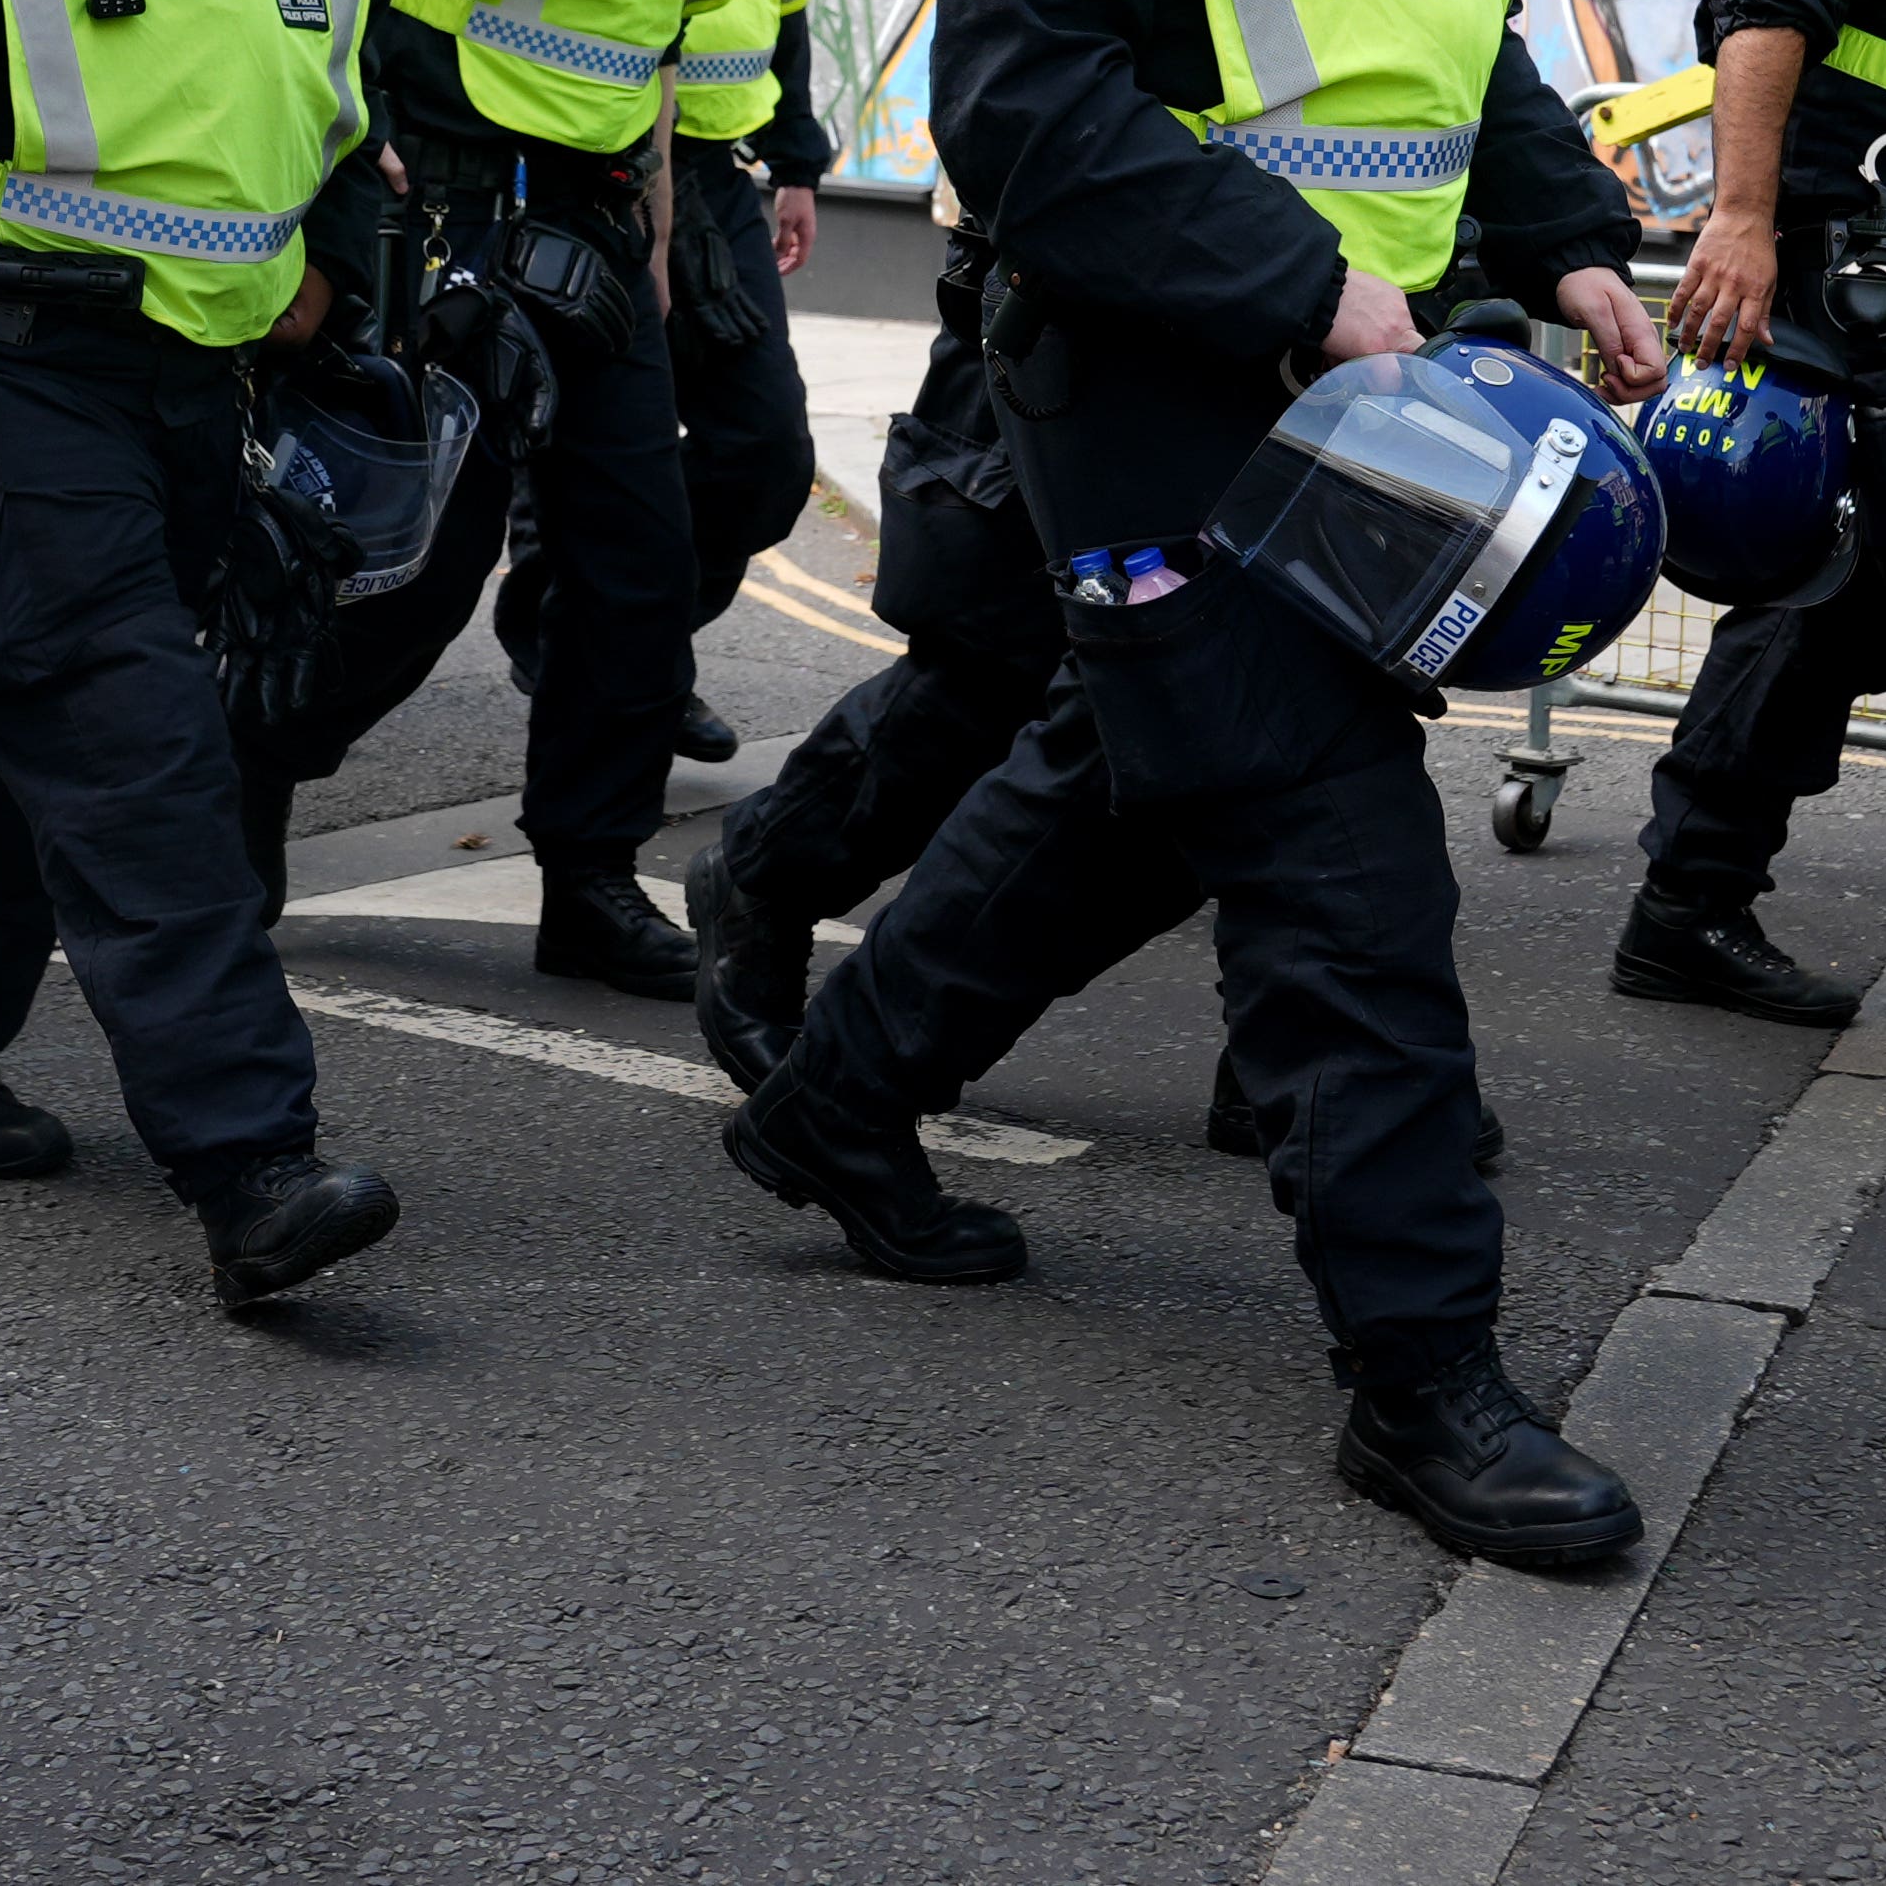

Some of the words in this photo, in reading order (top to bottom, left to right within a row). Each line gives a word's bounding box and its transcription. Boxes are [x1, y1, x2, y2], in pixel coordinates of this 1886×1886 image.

[1674, 385, 1733, 419] MP
[1655, 421, 1735, 453] 4058
[342, 572, 407, 594] POLICE
[1409, 598, 1480, 675] POLICE
[1539, 623, 1595, 677] MP
